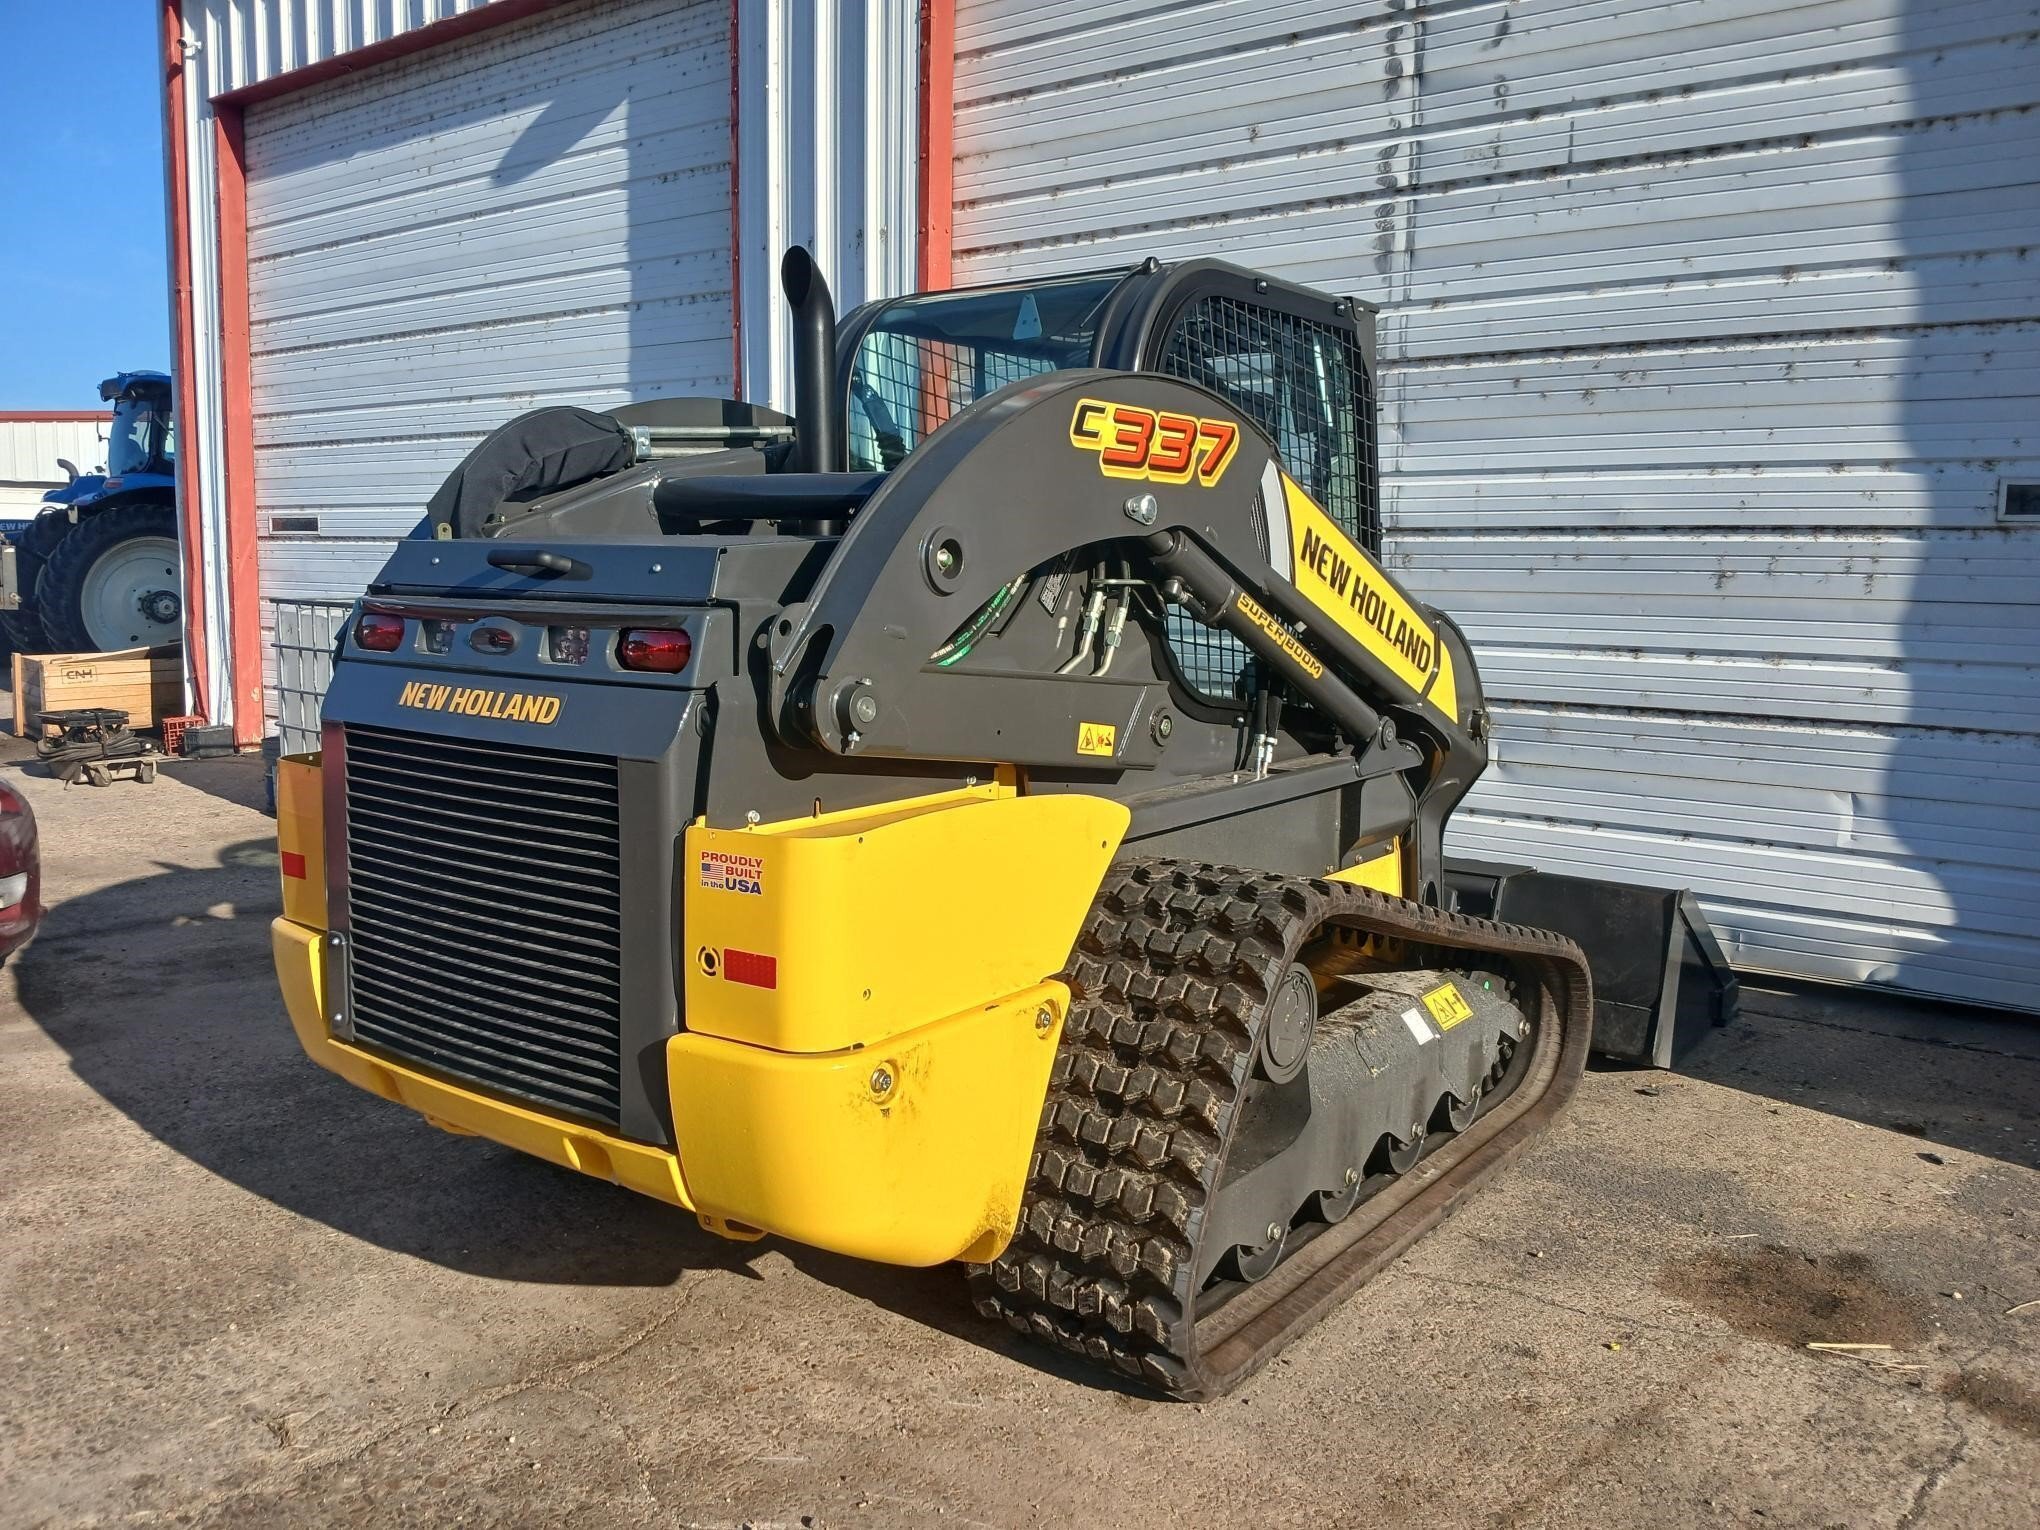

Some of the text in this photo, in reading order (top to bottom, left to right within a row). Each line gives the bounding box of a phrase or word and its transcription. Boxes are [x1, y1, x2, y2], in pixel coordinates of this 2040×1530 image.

[1072, 401, 1238, 482] C337
[1300, 526, 1432, 674] NEW HOLLAND
[1239, 594, 1285, 642] SUPER
[1284, 635, 1322, 676] BOOM
[66, 669, 93, 679] CNH
[399, 681, 560, 724] NEW HOLLAND
[701, 851, 763, 868] PROUDLY
[725, 865, 763, 880] BUILT
[710, 880, 724, 889] the
[725, 877, 762, 895] USA
